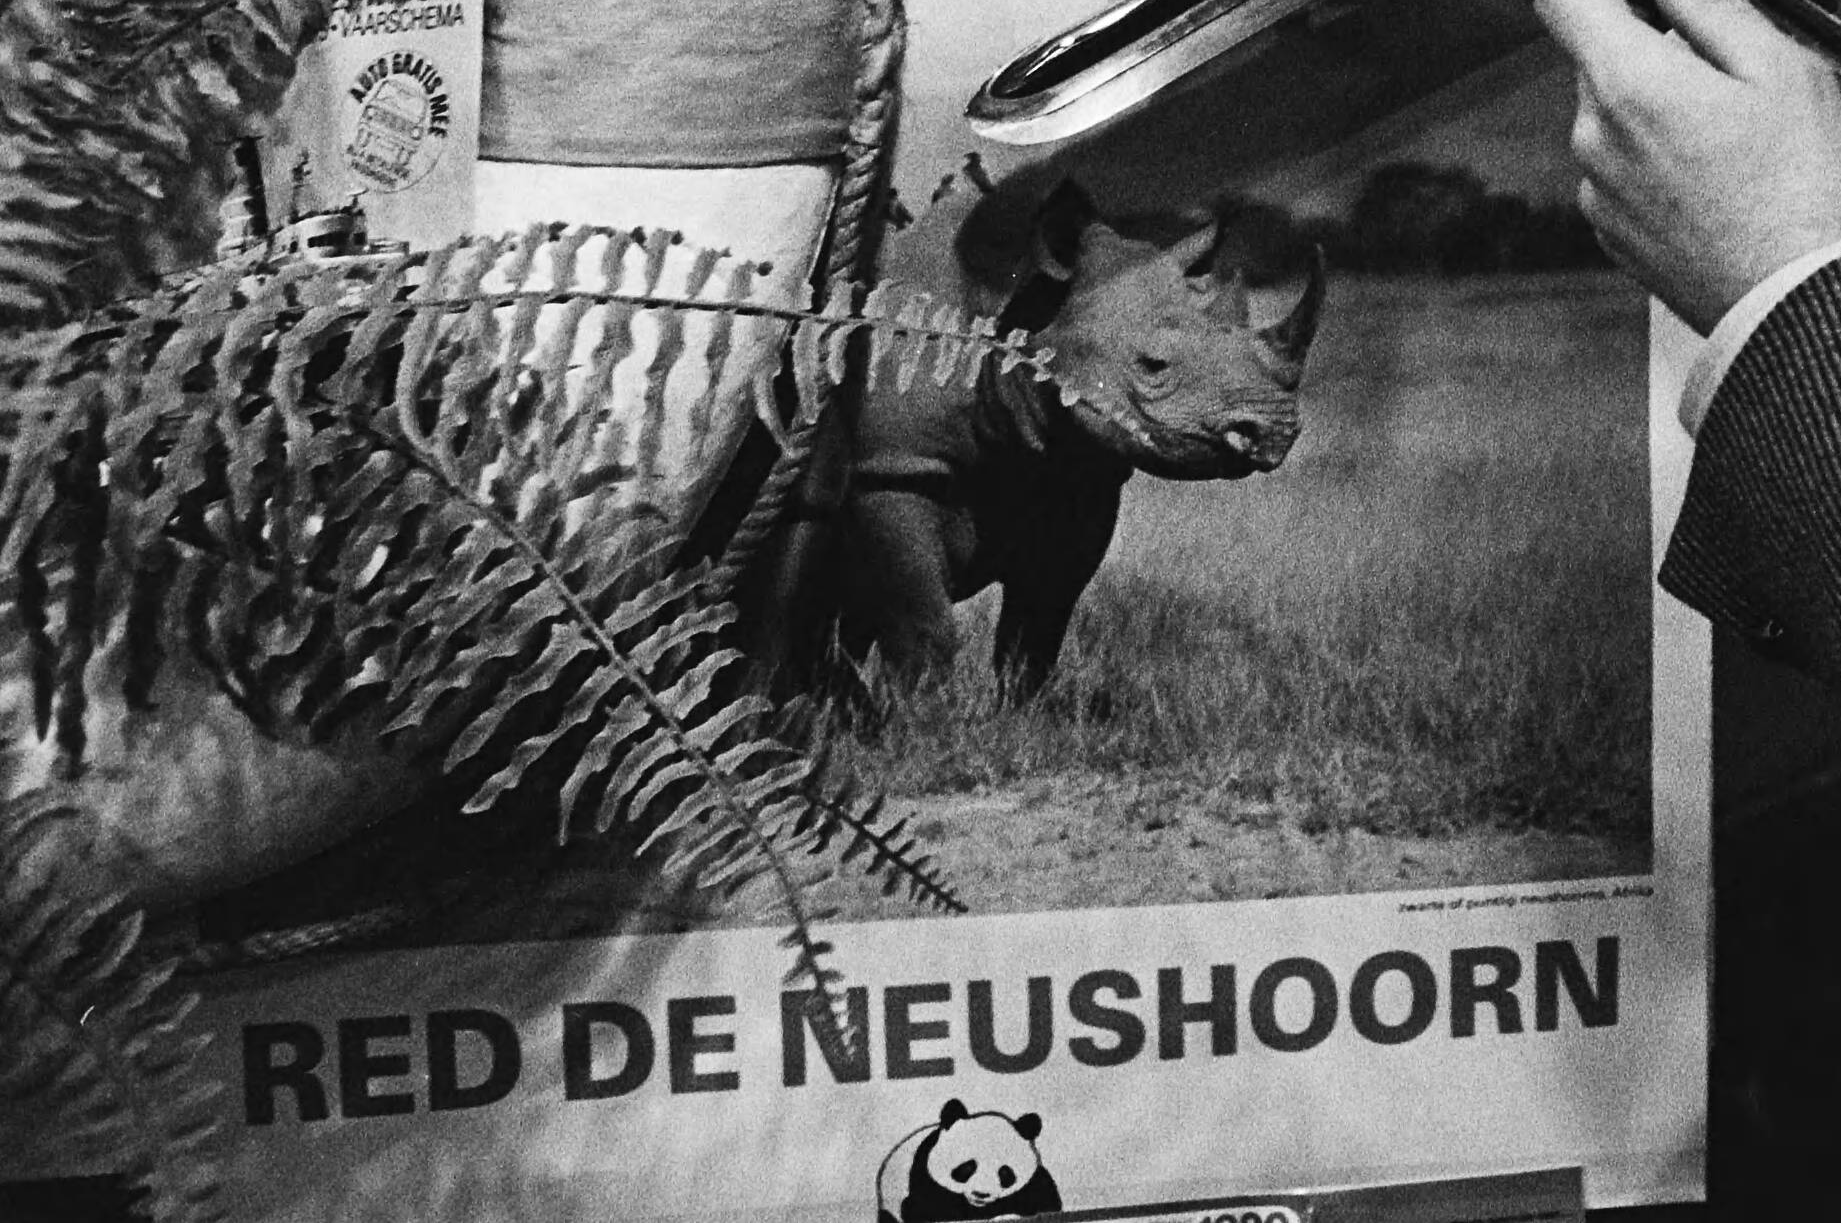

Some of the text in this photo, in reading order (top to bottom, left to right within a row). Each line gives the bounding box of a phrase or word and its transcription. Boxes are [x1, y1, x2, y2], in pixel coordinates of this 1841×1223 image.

[242, 935, 1621, 1125] RED DE NEUSHOORN
